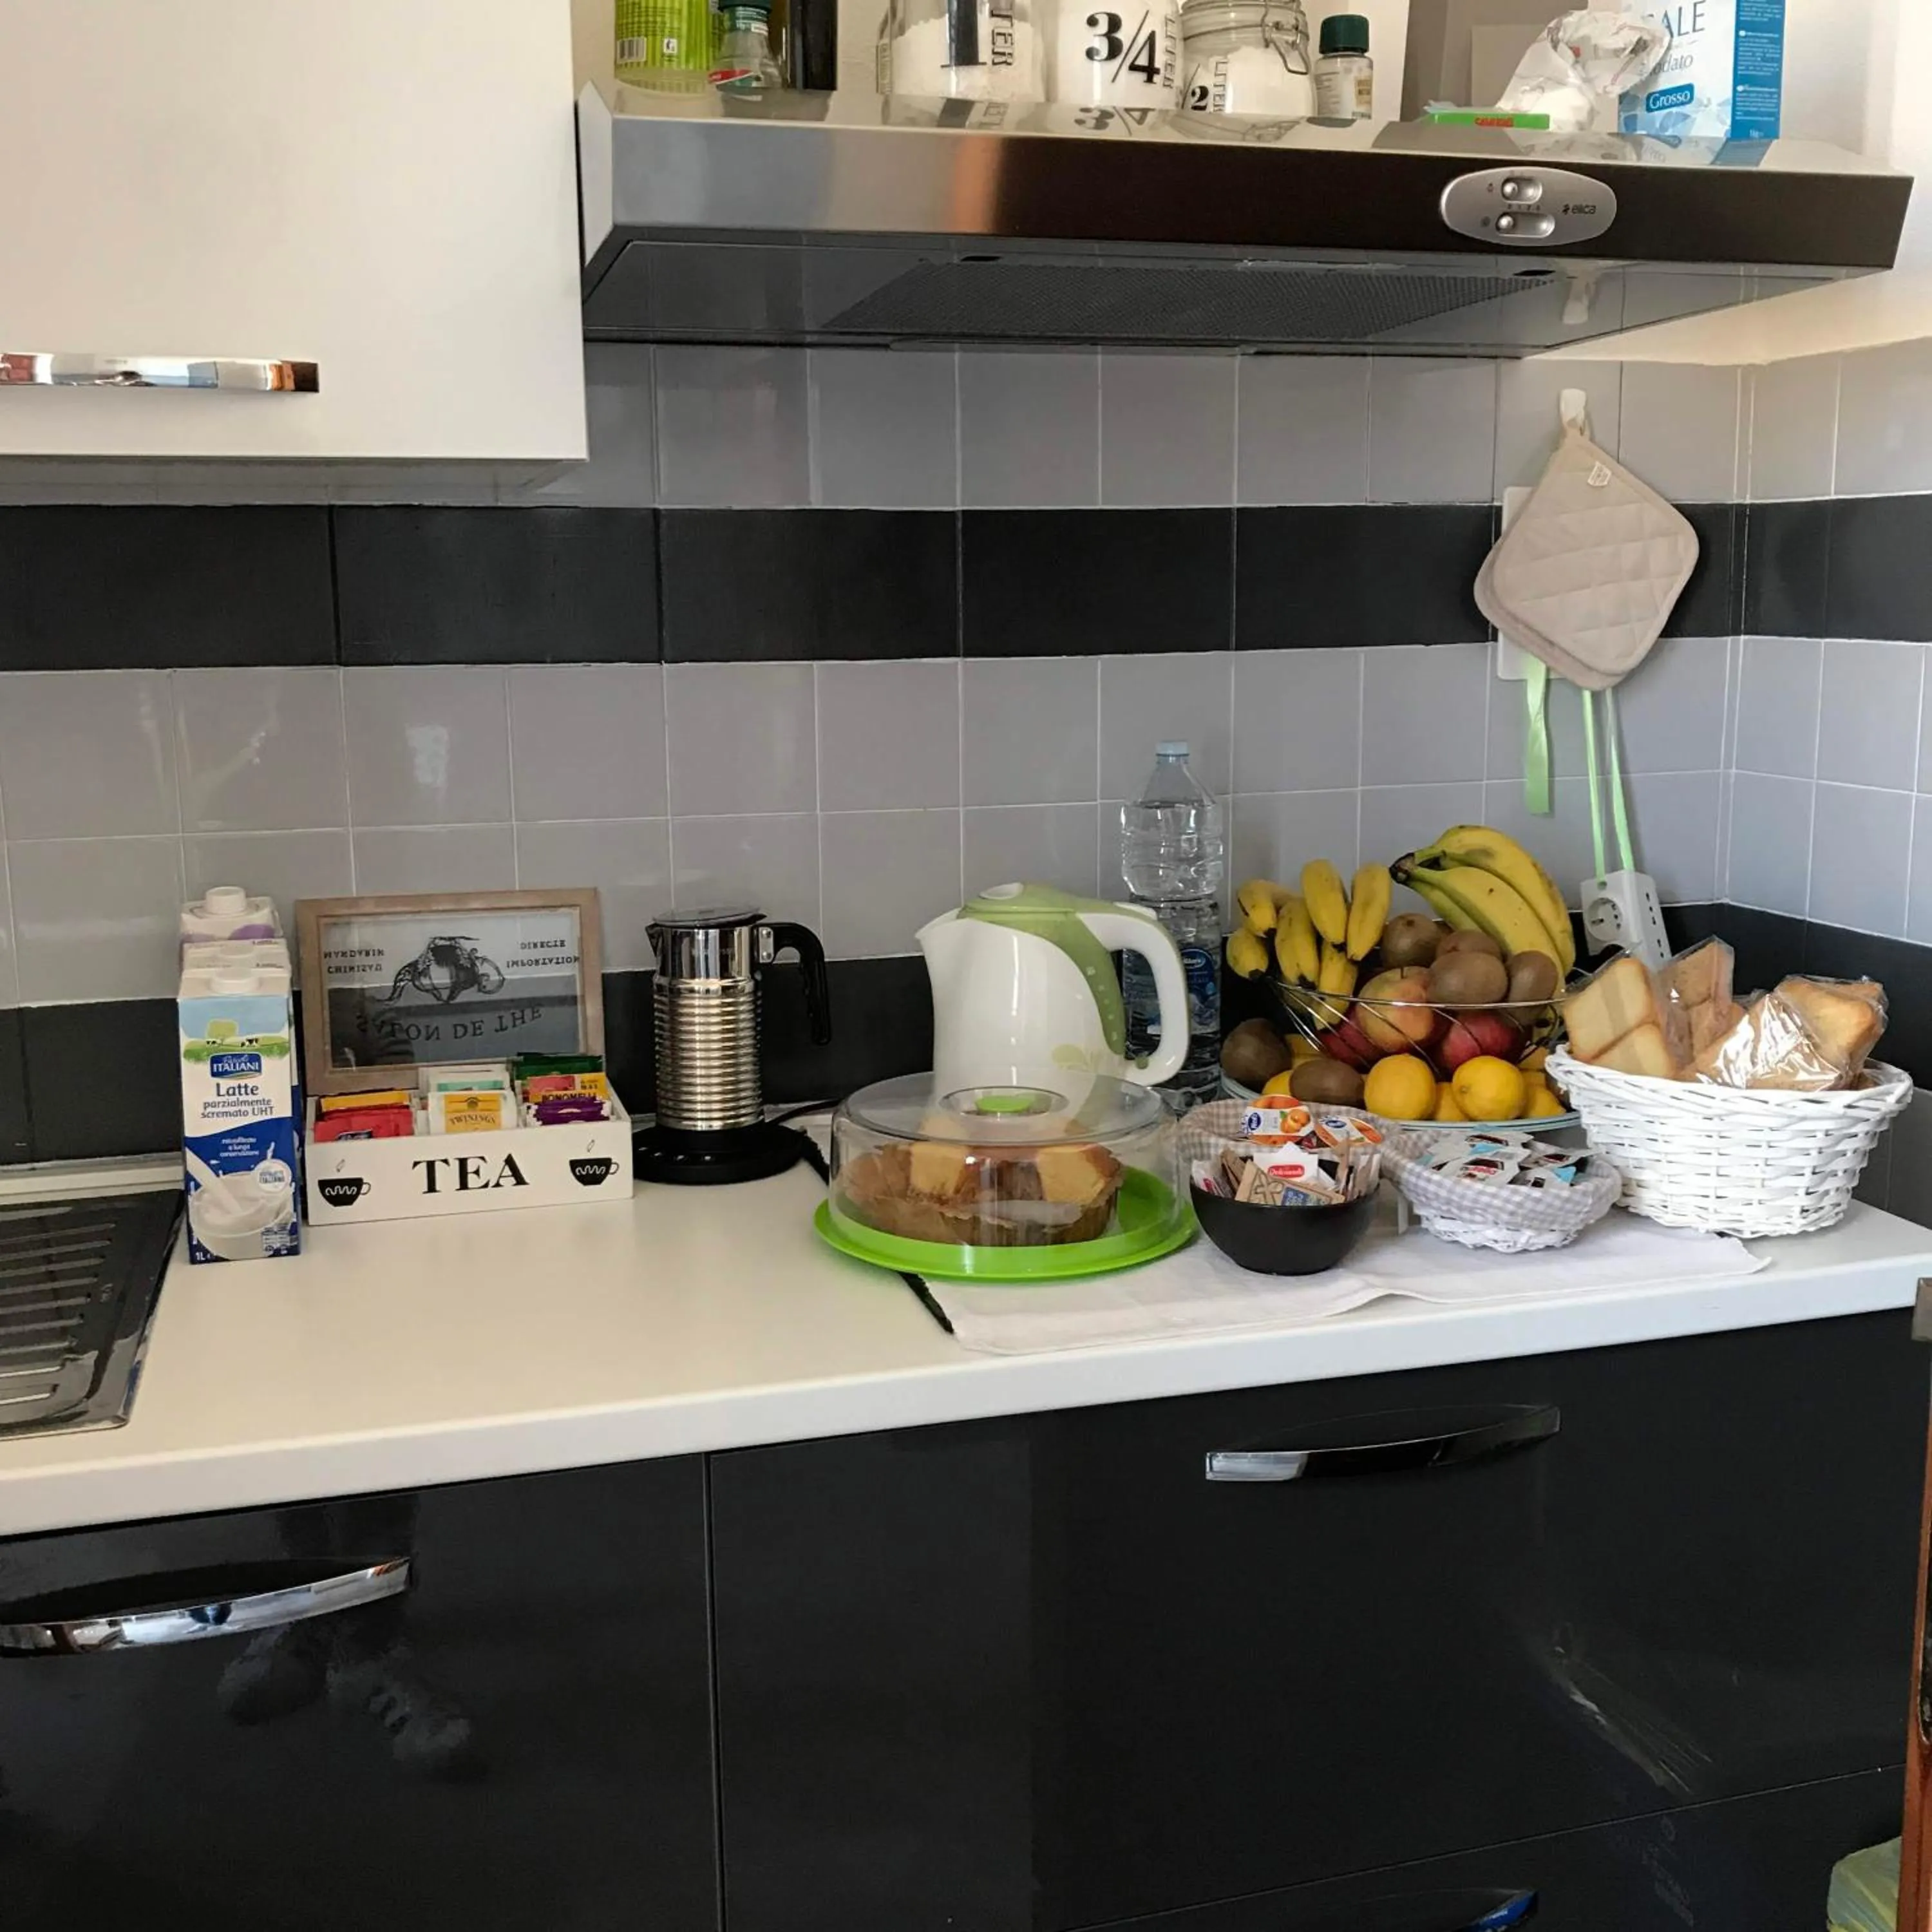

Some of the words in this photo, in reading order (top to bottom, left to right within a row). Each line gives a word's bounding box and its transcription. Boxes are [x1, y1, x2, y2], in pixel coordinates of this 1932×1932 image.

[1647, 0, 1706, 38] ALE
[1085, 10, 1161, 84] 3/4
[1162, 15, 1177, 89] LITER
[1213, 61, 1229, 113] LITER
[1649, 90, 1690, 109] Grosso
[1571, 204, 1596, 214] elica
[213, 1062, 258, 1072] ITALIANI
[216, 1083, 260, 1097] Latte
[200, 1108, 249, 1119] scremato
[252, 1105, 274, 1117] UHT
[203, 1097, 272, 1111] parzialmente
[412, 1153, 529, 1194] TEA
